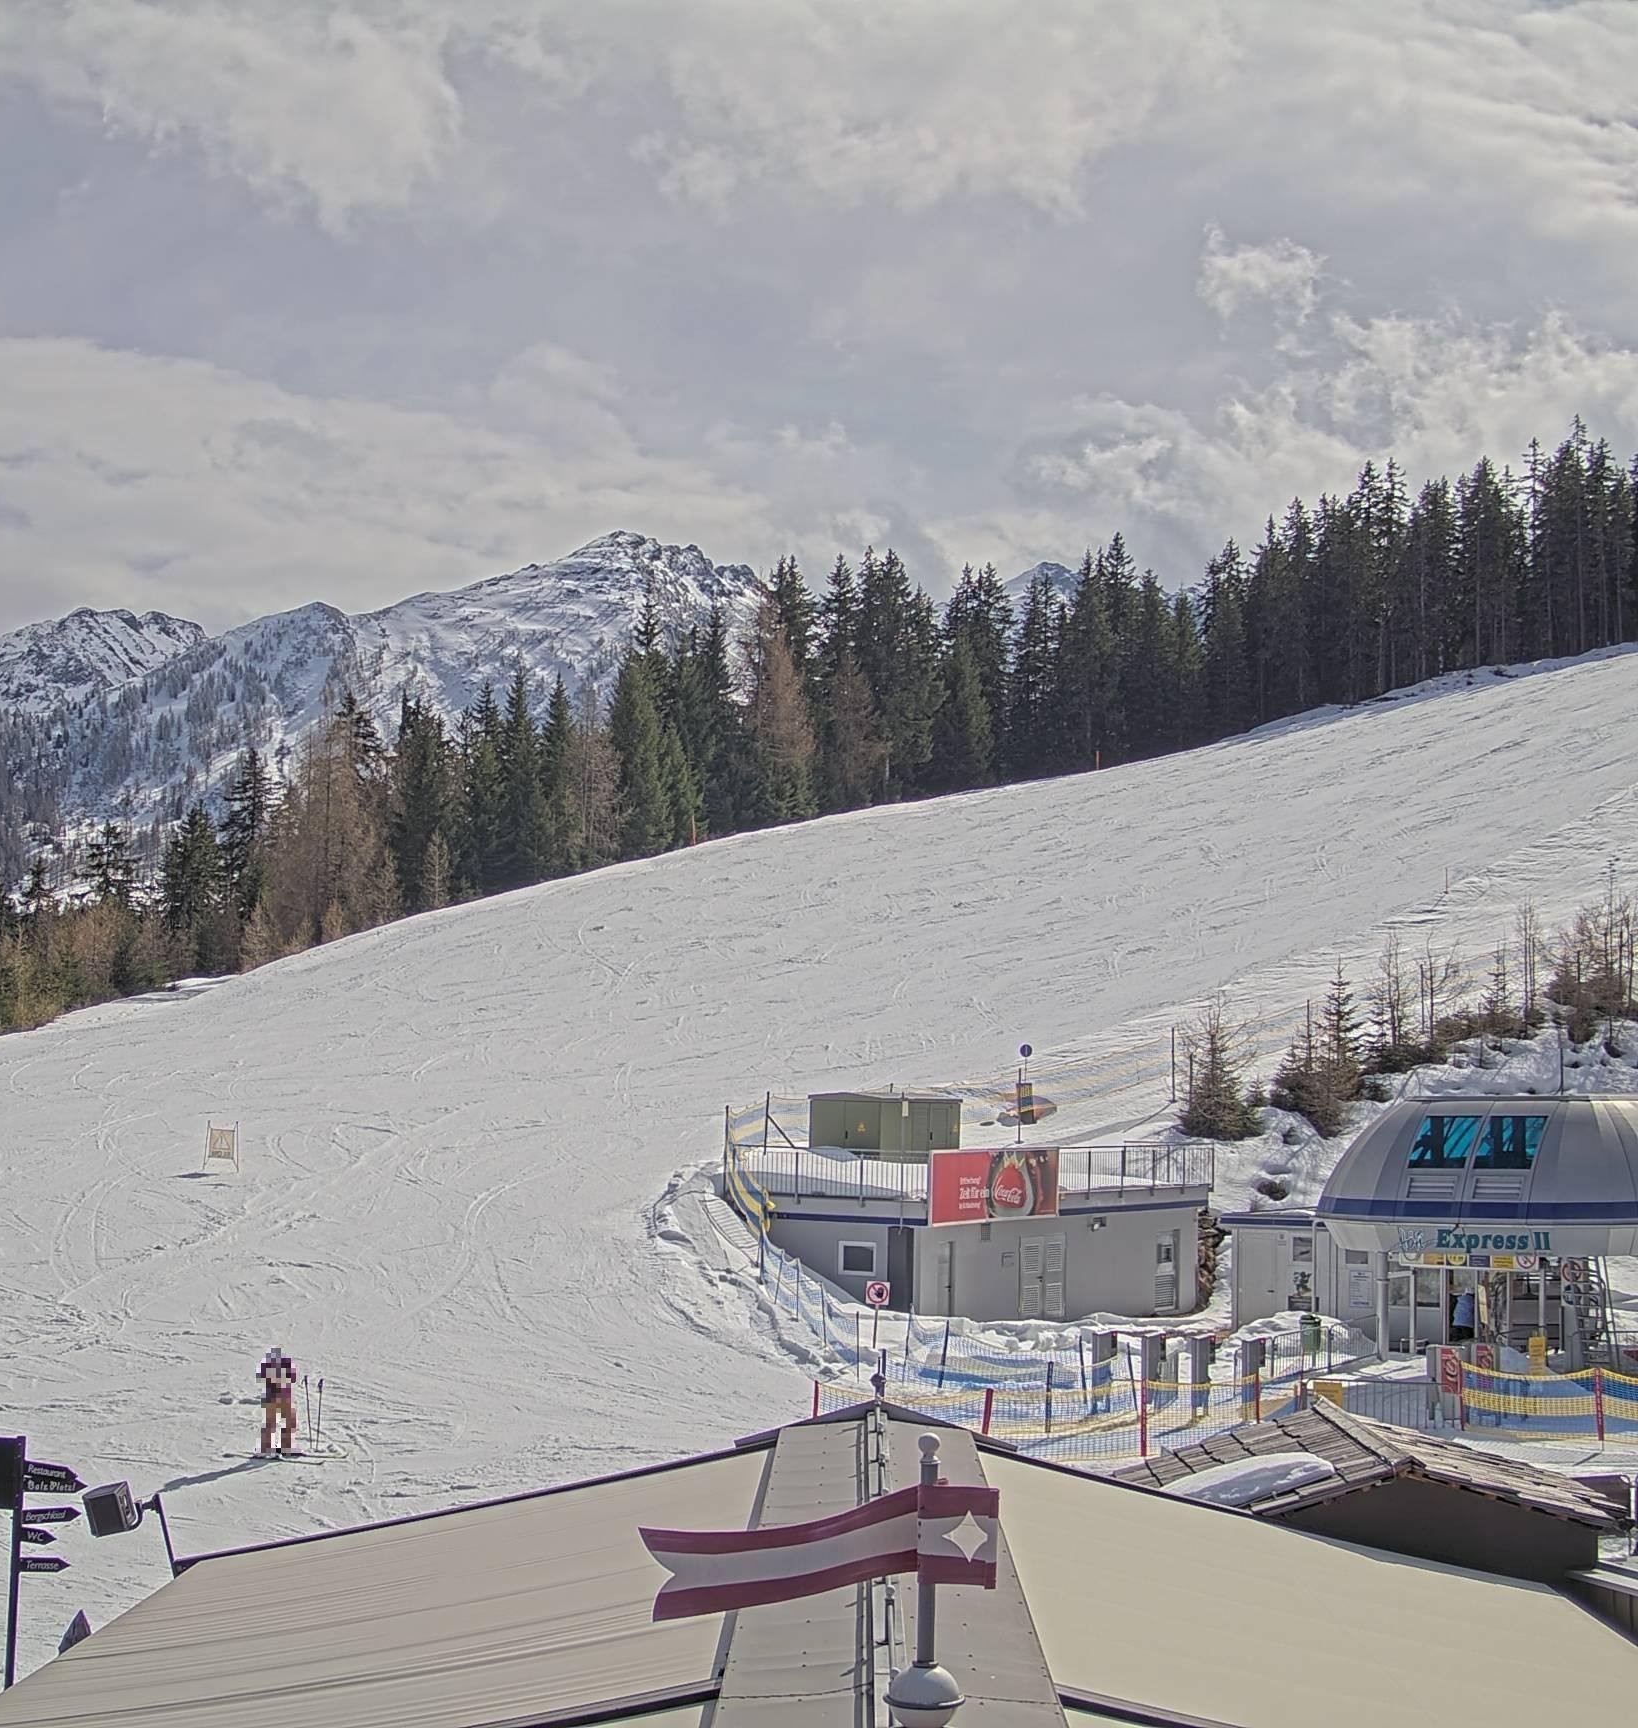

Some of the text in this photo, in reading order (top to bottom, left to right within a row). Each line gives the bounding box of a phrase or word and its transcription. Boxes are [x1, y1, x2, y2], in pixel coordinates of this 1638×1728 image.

[1435, 1229, 1529, 1253] Express
[28, 1465, 66, 1478] Restaurant
[27, 1531, 44, 1541] WC
[26, 1560, 59, 1570] Terrasse
